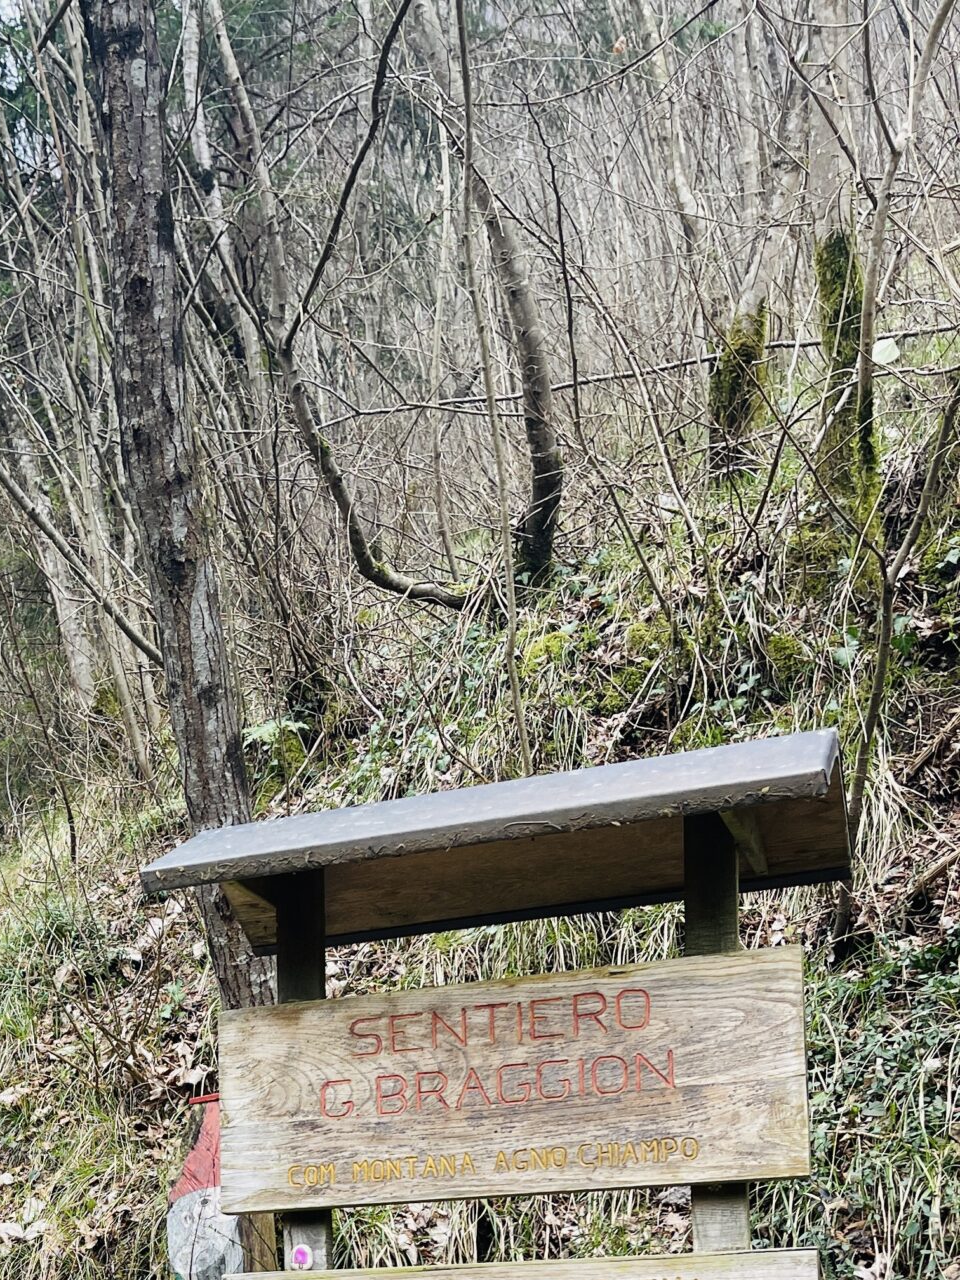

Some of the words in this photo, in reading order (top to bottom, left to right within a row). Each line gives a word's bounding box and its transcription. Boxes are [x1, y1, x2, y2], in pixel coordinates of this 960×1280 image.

[348, 988, 652, 1059] SENTIERO
[320, 1080, 361, 1119] G.
[376, 1049, 675, 1116] BRAGGION
[288, 1164, 336, 1188] COM
[352, 1152, 476, 1183] MONTANA
[495, 1145, 566, 1171] AGNO
[577, 1137, 700, 1168] CHIAMPO
